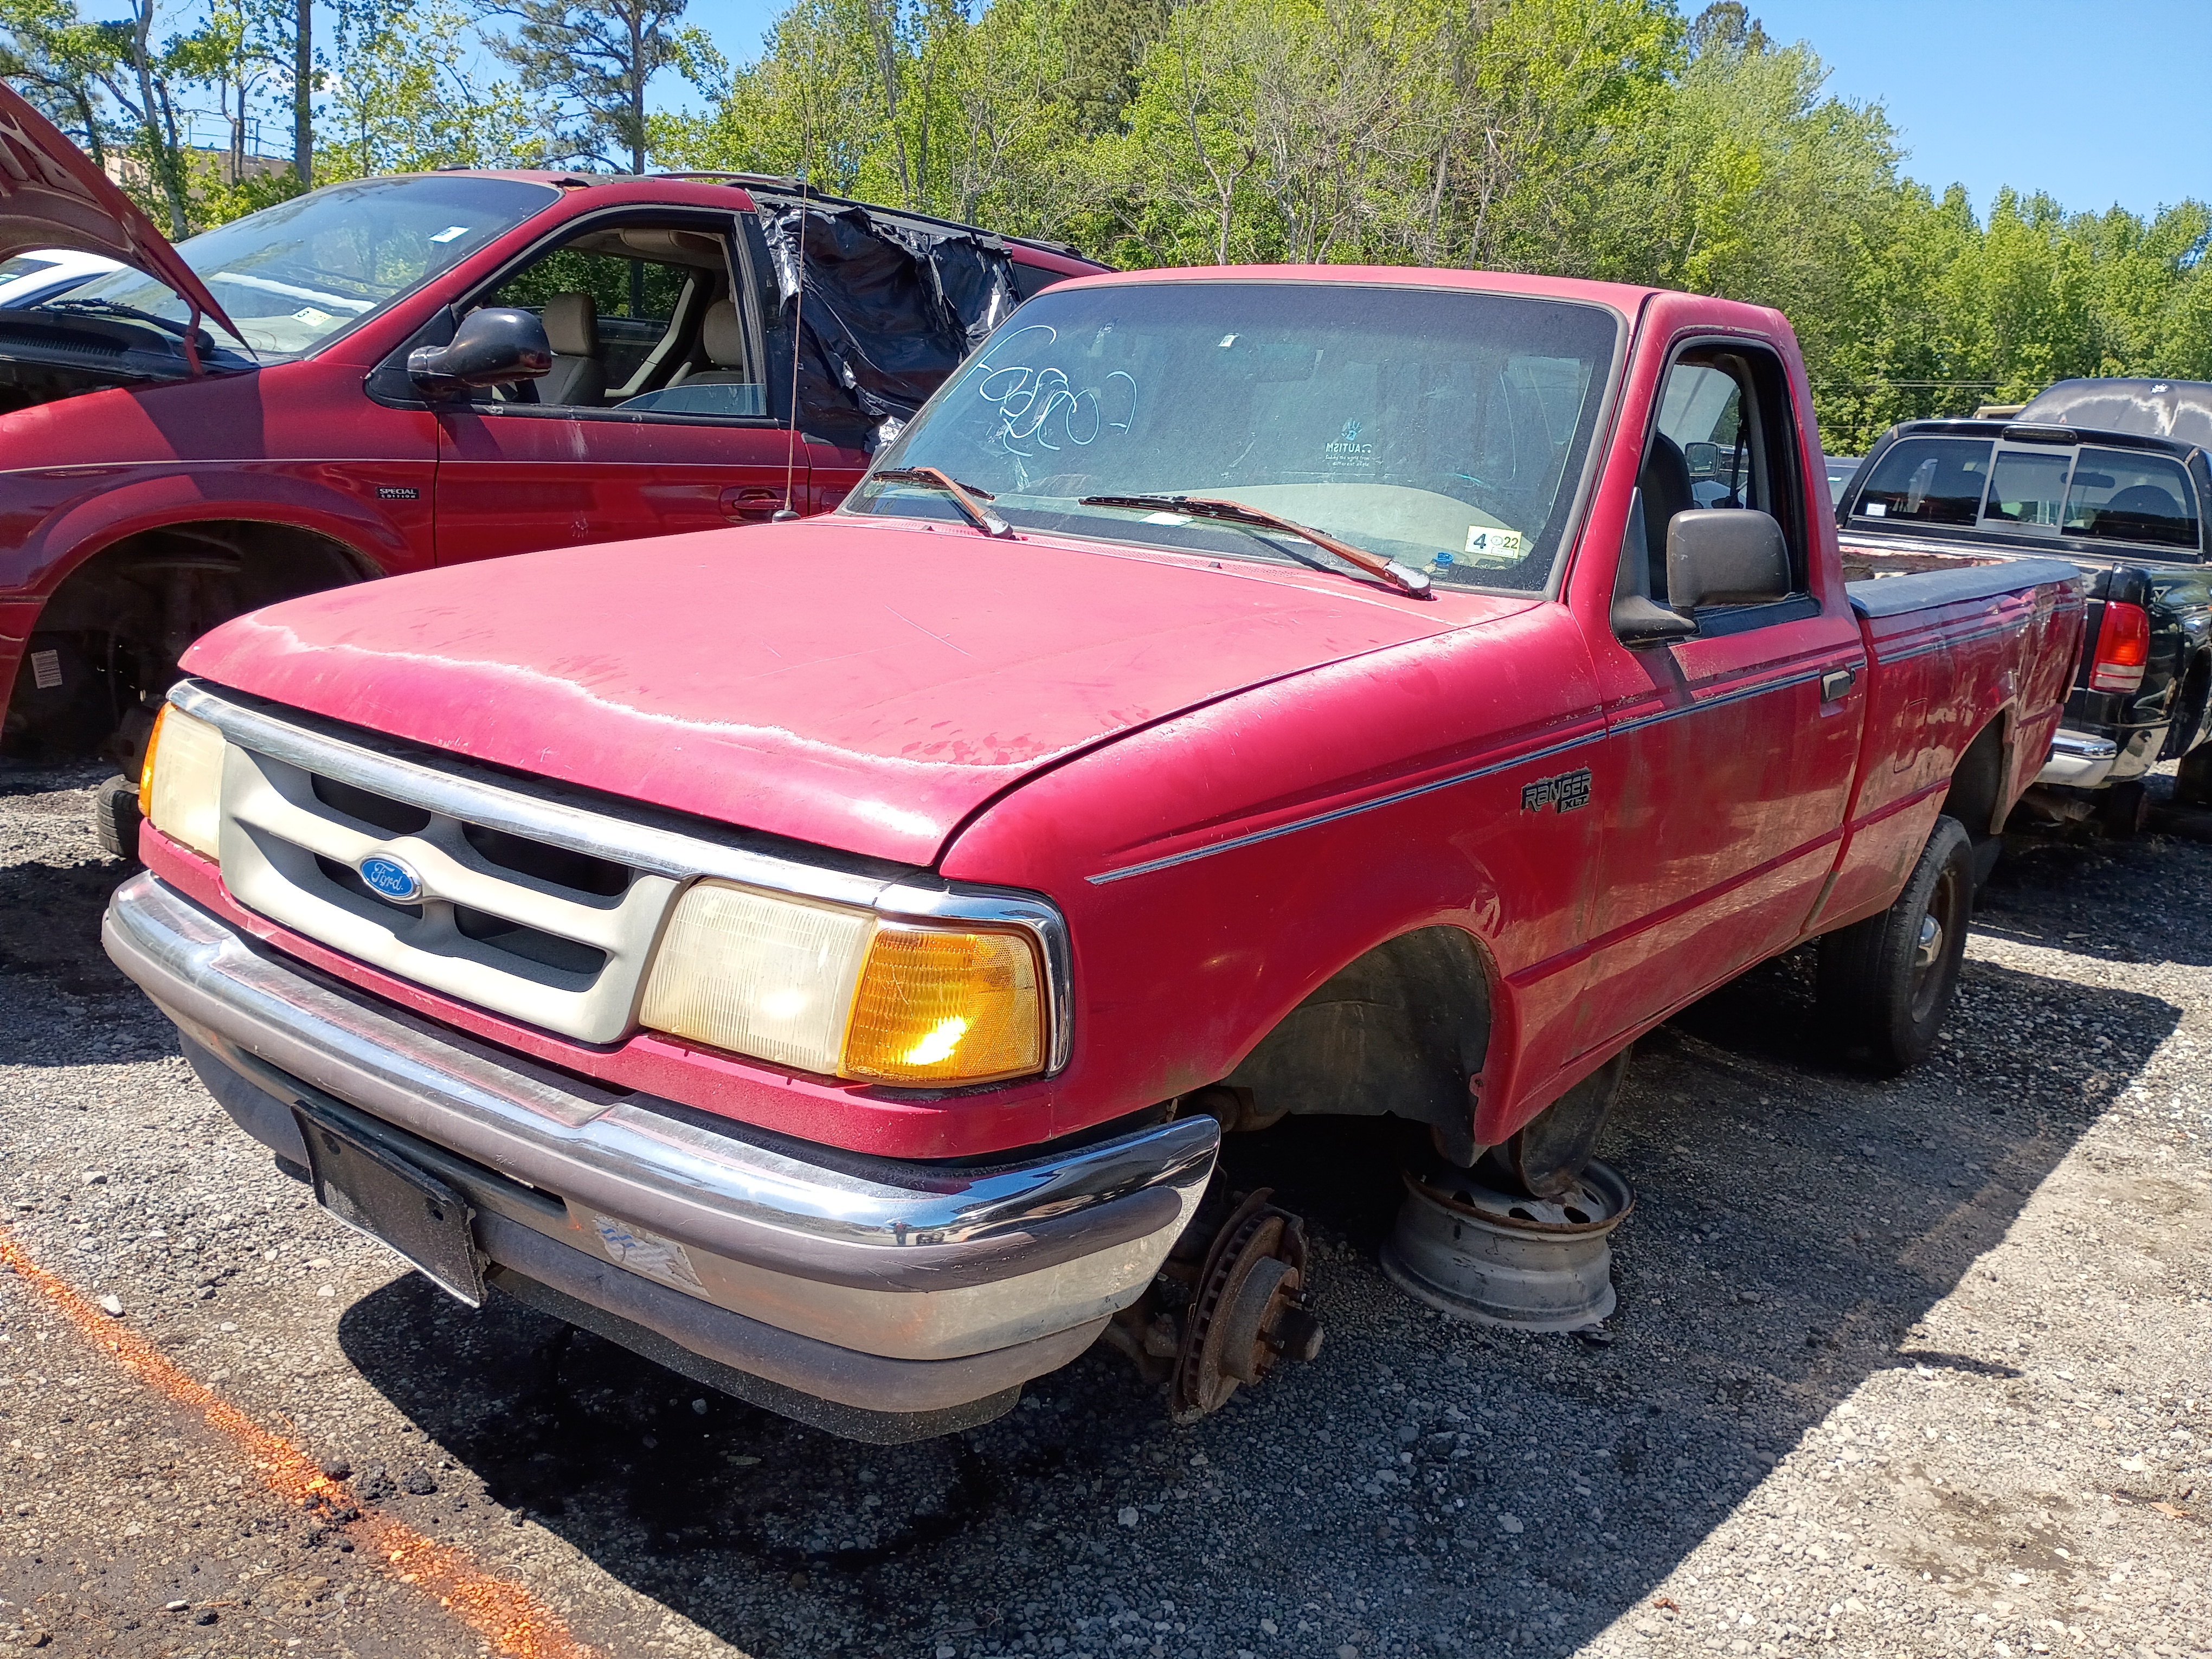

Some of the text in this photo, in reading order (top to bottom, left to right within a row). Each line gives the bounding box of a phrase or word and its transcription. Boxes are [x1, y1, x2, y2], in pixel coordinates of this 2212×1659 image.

[1474, 533, 1519, 549] 4 22
[1525, 773, 1592, 811] RANGER
[1564, 795, 1587, 810] XLT
[371, 863, 403, 891] Ford
